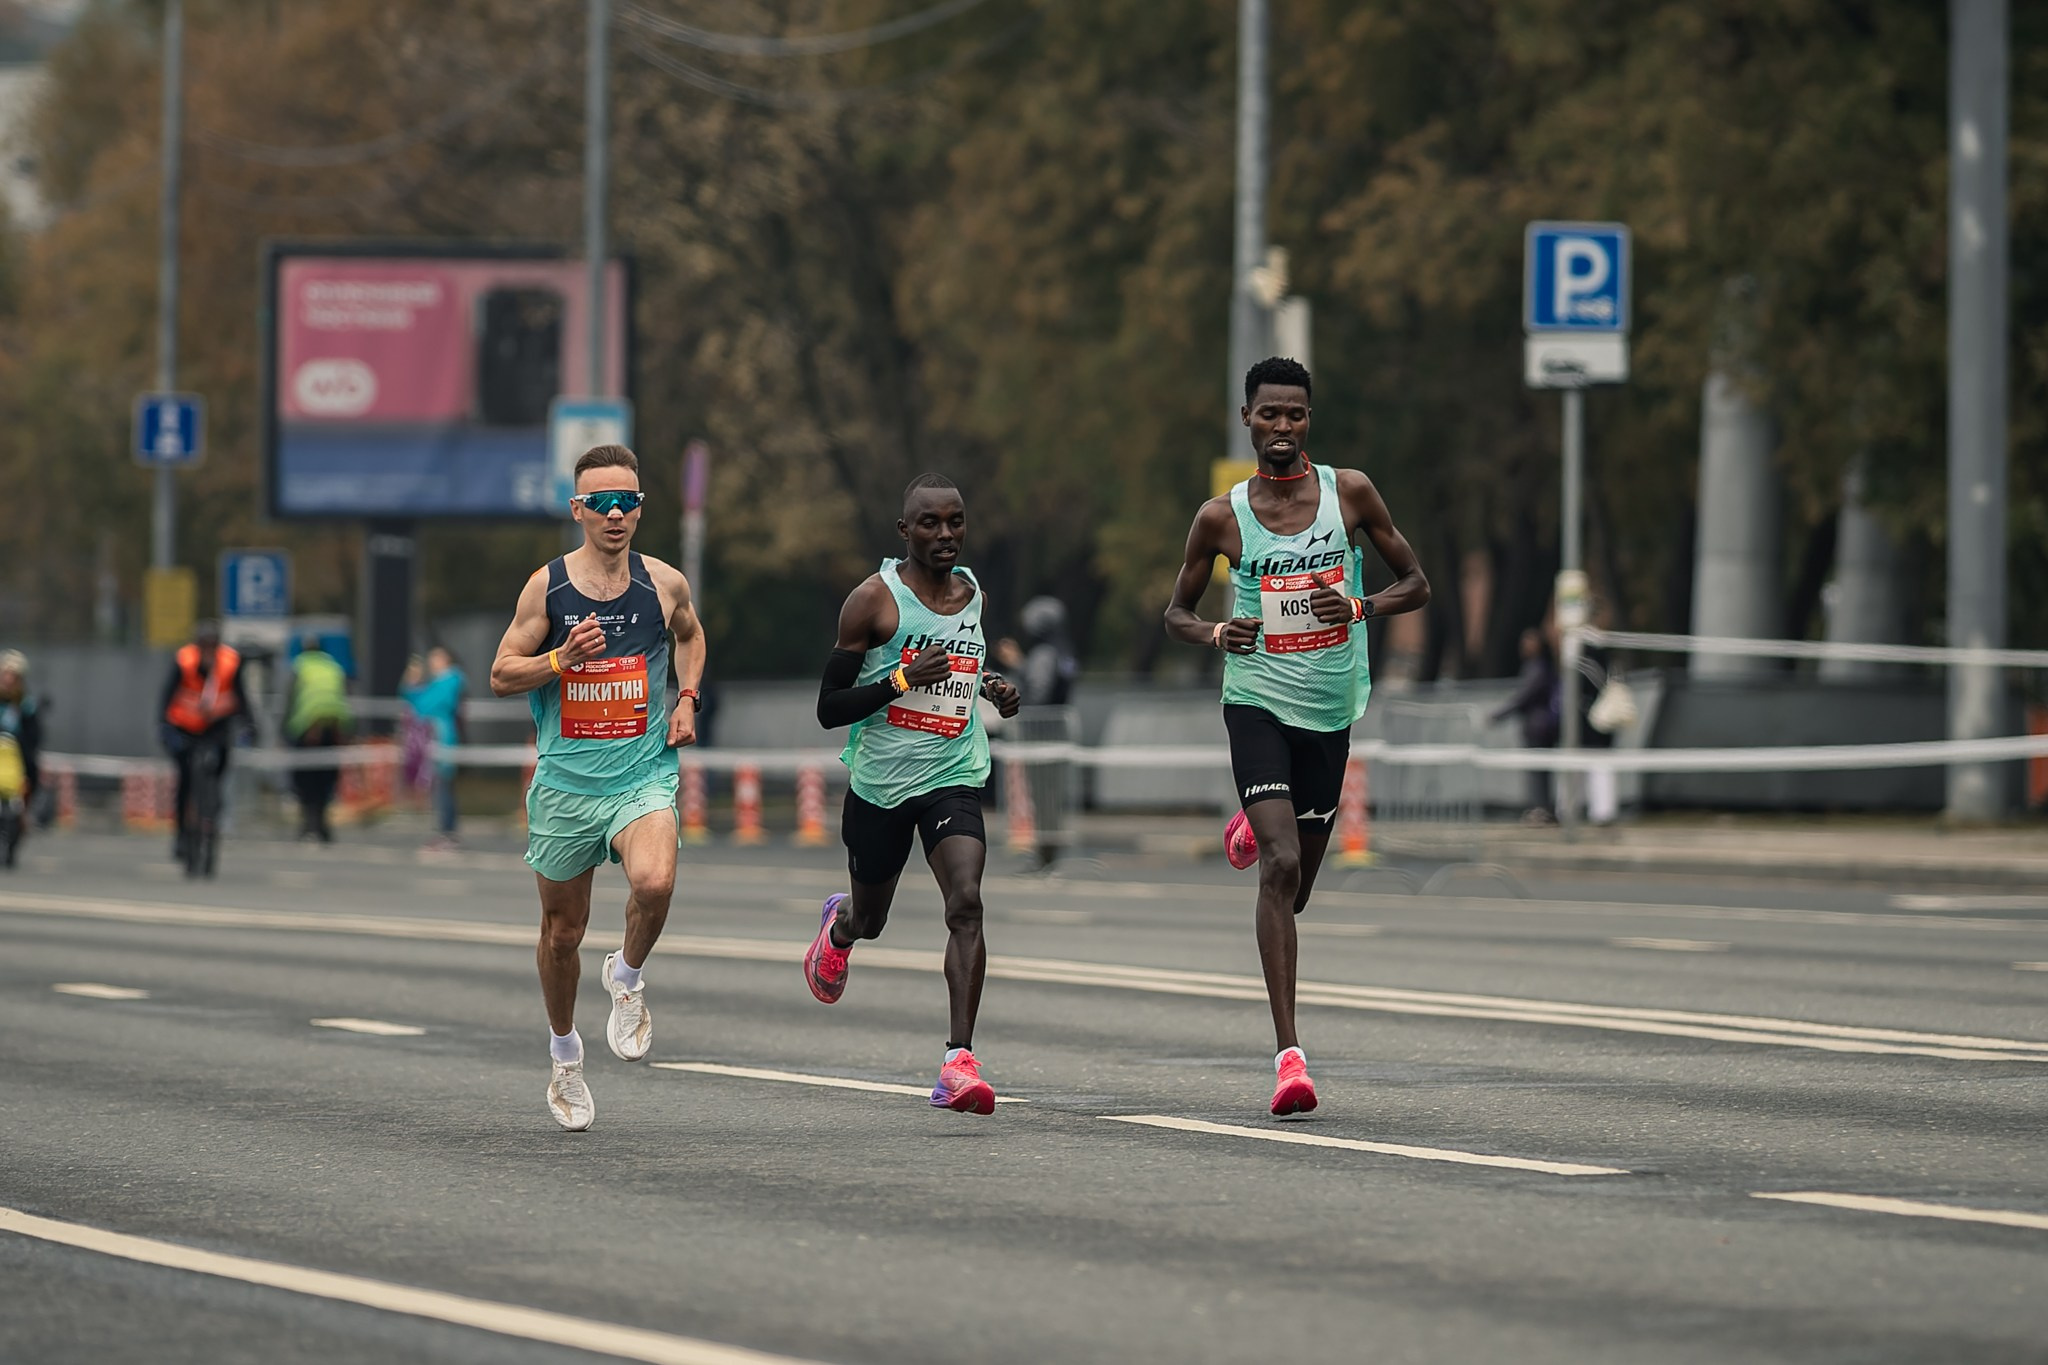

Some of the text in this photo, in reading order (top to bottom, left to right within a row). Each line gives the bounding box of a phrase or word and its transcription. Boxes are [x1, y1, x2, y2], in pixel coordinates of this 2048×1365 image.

[1553, 237, 1611, 321] P
[1250, 549, 1346, 577] HIRACER
[1280, 598, 1310, 617] KOS
[566, 679, 643, 702] НИКИТИН
[909, 680, 974, 699] KEMBOI
[603, 708, 608, 716] 1
[931, 704, 941, 712] 28
